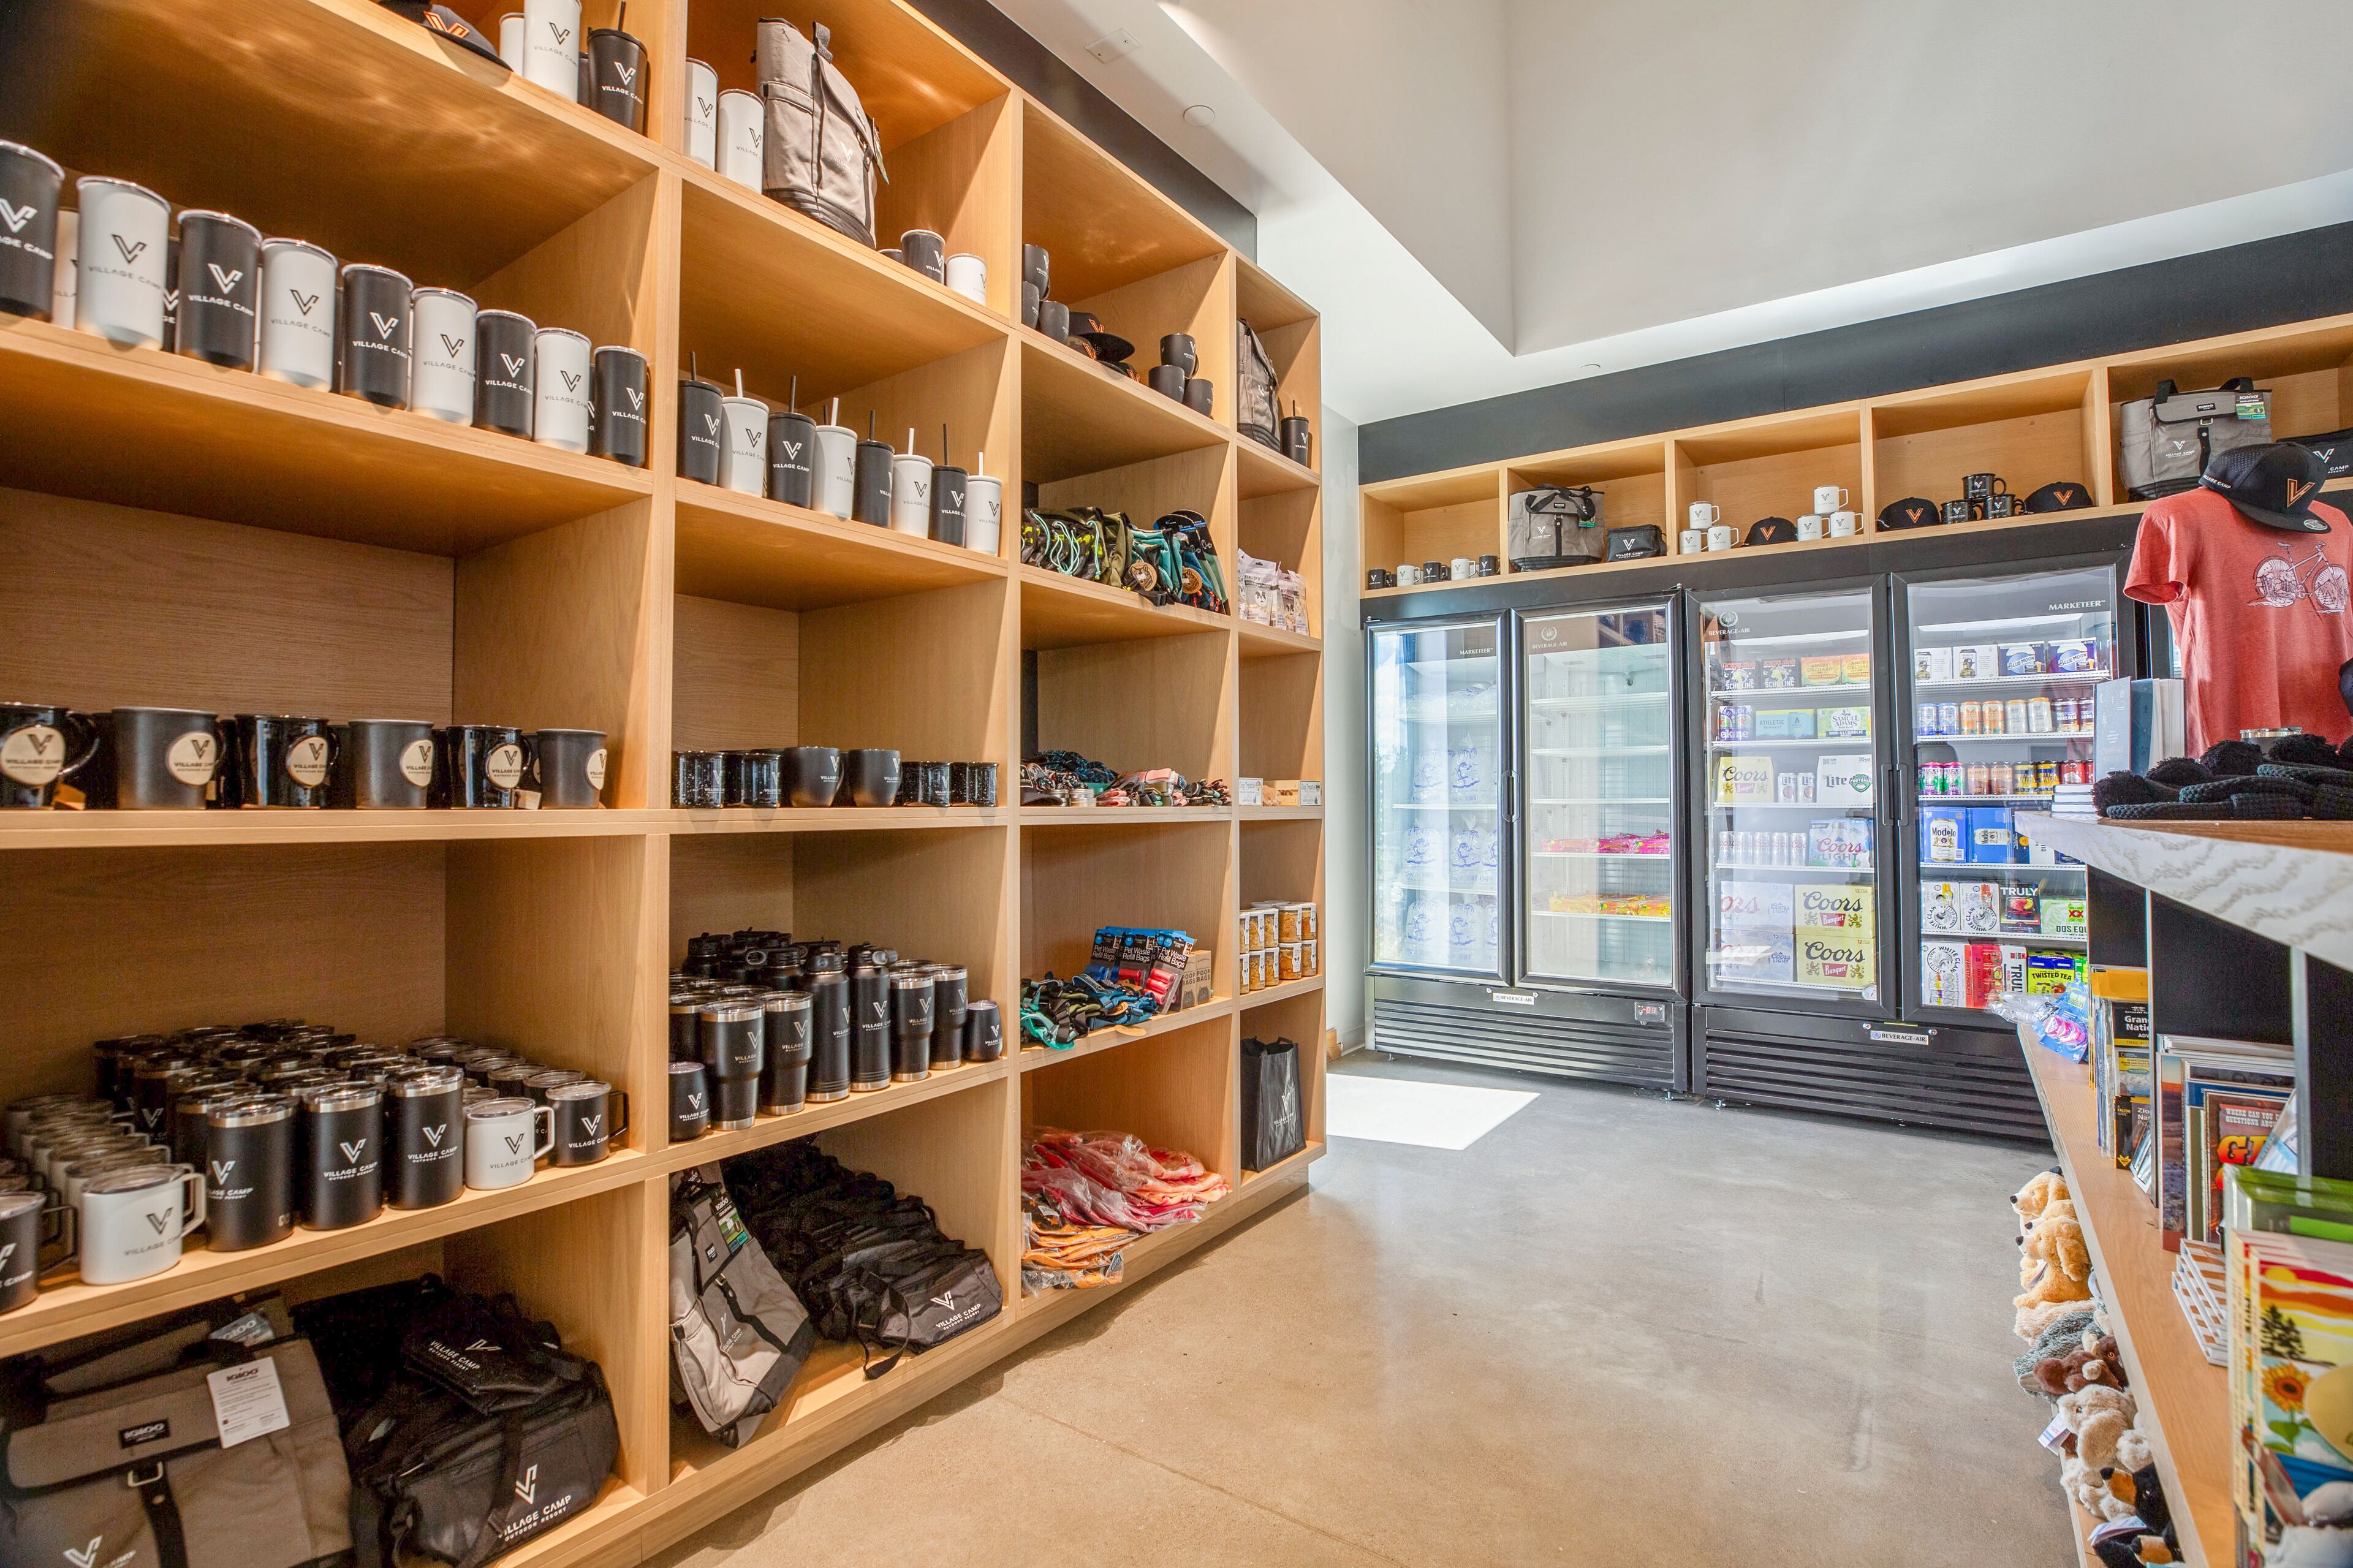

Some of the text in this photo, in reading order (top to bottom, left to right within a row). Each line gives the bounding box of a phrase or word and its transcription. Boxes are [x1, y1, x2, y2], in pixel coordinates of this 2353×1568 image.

[534, 45, 563, 56] VILLAGE
[602, 85, 629, 96] VILLAGE
[88, 265, 133, 279] VILLAGE
[188, 294, 231, 308] VILLAGE
[270, 319, 309, 330] VILLAGE
[353, 341, 389, 352] VILLAGE
[423, 360, 457, 370] VILLAGE
[485, 380, 517, 389] VILLAGE
[545, 395, 575, 404] VILLAGE
[612, 411, 640, 421] VILLAGE
[691, 436, 714, 447] VILLAGE
[1708, 627, 1751, 636] BEVERAGE-AIR
[1532, 641, 1567, 650] BEVERAGE-AIR
[2007, 659, 2021, 668] BLUE
[2059, 653, 2087, 667] BLUE MOON
[1722, 766, 1768, 782] Coors
[1781, 776, 1795, 786] Lite
[1825, 776, 1847, 788] Lite
[1737, 784, 1754, 792] Banquet
[1932, 827, 1956, 837] Modelo
[1817, 838, 1863, 853] Coors
[2000, 887, 2039, 896] TRULY
[1770, 903, 1790, 911] Coors
[1803, 892, 1863, 912] Coors
[1822, 915, 1844, 925] Banquet
[1928, 906, 1947, 930] WHITE CLAW
[1966, 907, 1987, 931] WHITE CLAW
[1161, 947, 1170, 956] Pet
[1170, 950, 1186, 961] Waste
[1771, 952, 1790, 961] Coors
[1805, 941, 1865, 963] Coors
[1158, 953, 1170, 963] Refill
[1170, 956, 1185, 968] Bags
[1938, 946, 1961, 973] WHITE CLAW
[1825, 964, 1847, 975] Banquet
[1882, 1033, 1925, 1042] BEVERAGE-AIR
[2226, 1108, 2246, 1117] WHERE
[2225, 1116, 2259, 1126] QUESTIONS
[568, 1140, 595, 1149] VILLAGE
[407, 1146, 458, 1161] VILLAGE CAMP
[324, 1161, 378, 1178] VILLAGE CAMP
[490, 1159, 518, 1169] VILLAGE
[227, 1187, 254, 1196] CAMP
[715, 1198, 729, 1211] IGLOO
[124, 1240, 164, 1257] VILLAGE
[935, 1303, 981, 1328] VILLAGE CAMP
[943, 1310, 980, 1330] OUTDOOR RESORT
[430, 1340, 480, 1370] VILLAGE CAMP
[543, 1494, 572, 1514] CAMP
[504, 1506, 567, 1542] OUTDOOR RESORT
